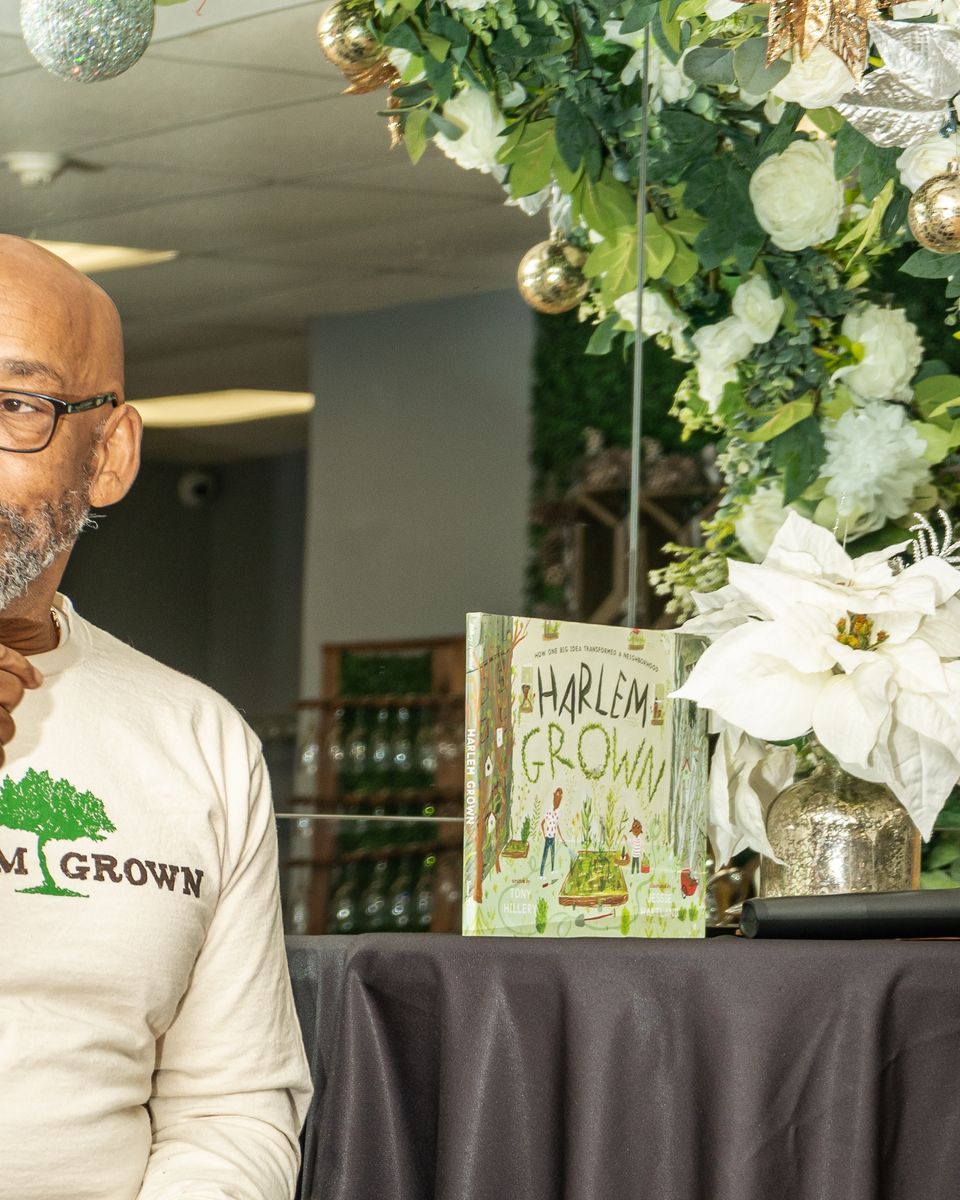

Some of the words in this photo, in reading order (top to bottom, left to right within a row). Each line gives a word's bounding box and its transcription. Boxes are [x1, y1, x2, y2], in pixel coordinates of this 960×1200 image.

[548, 647, 558, 655] ONE
[583, 645, 617, 655] TRANSFORMED
[537, 662, 649, 728] HARLEM
[466, 728, 476, 775] HARLEM
[521, 721, 666, 803] GROWN
[466, 781, 476, 825] GROWN
[59, 851, 205, 899] GROWN
[510, 888, 531, 899] TONY
